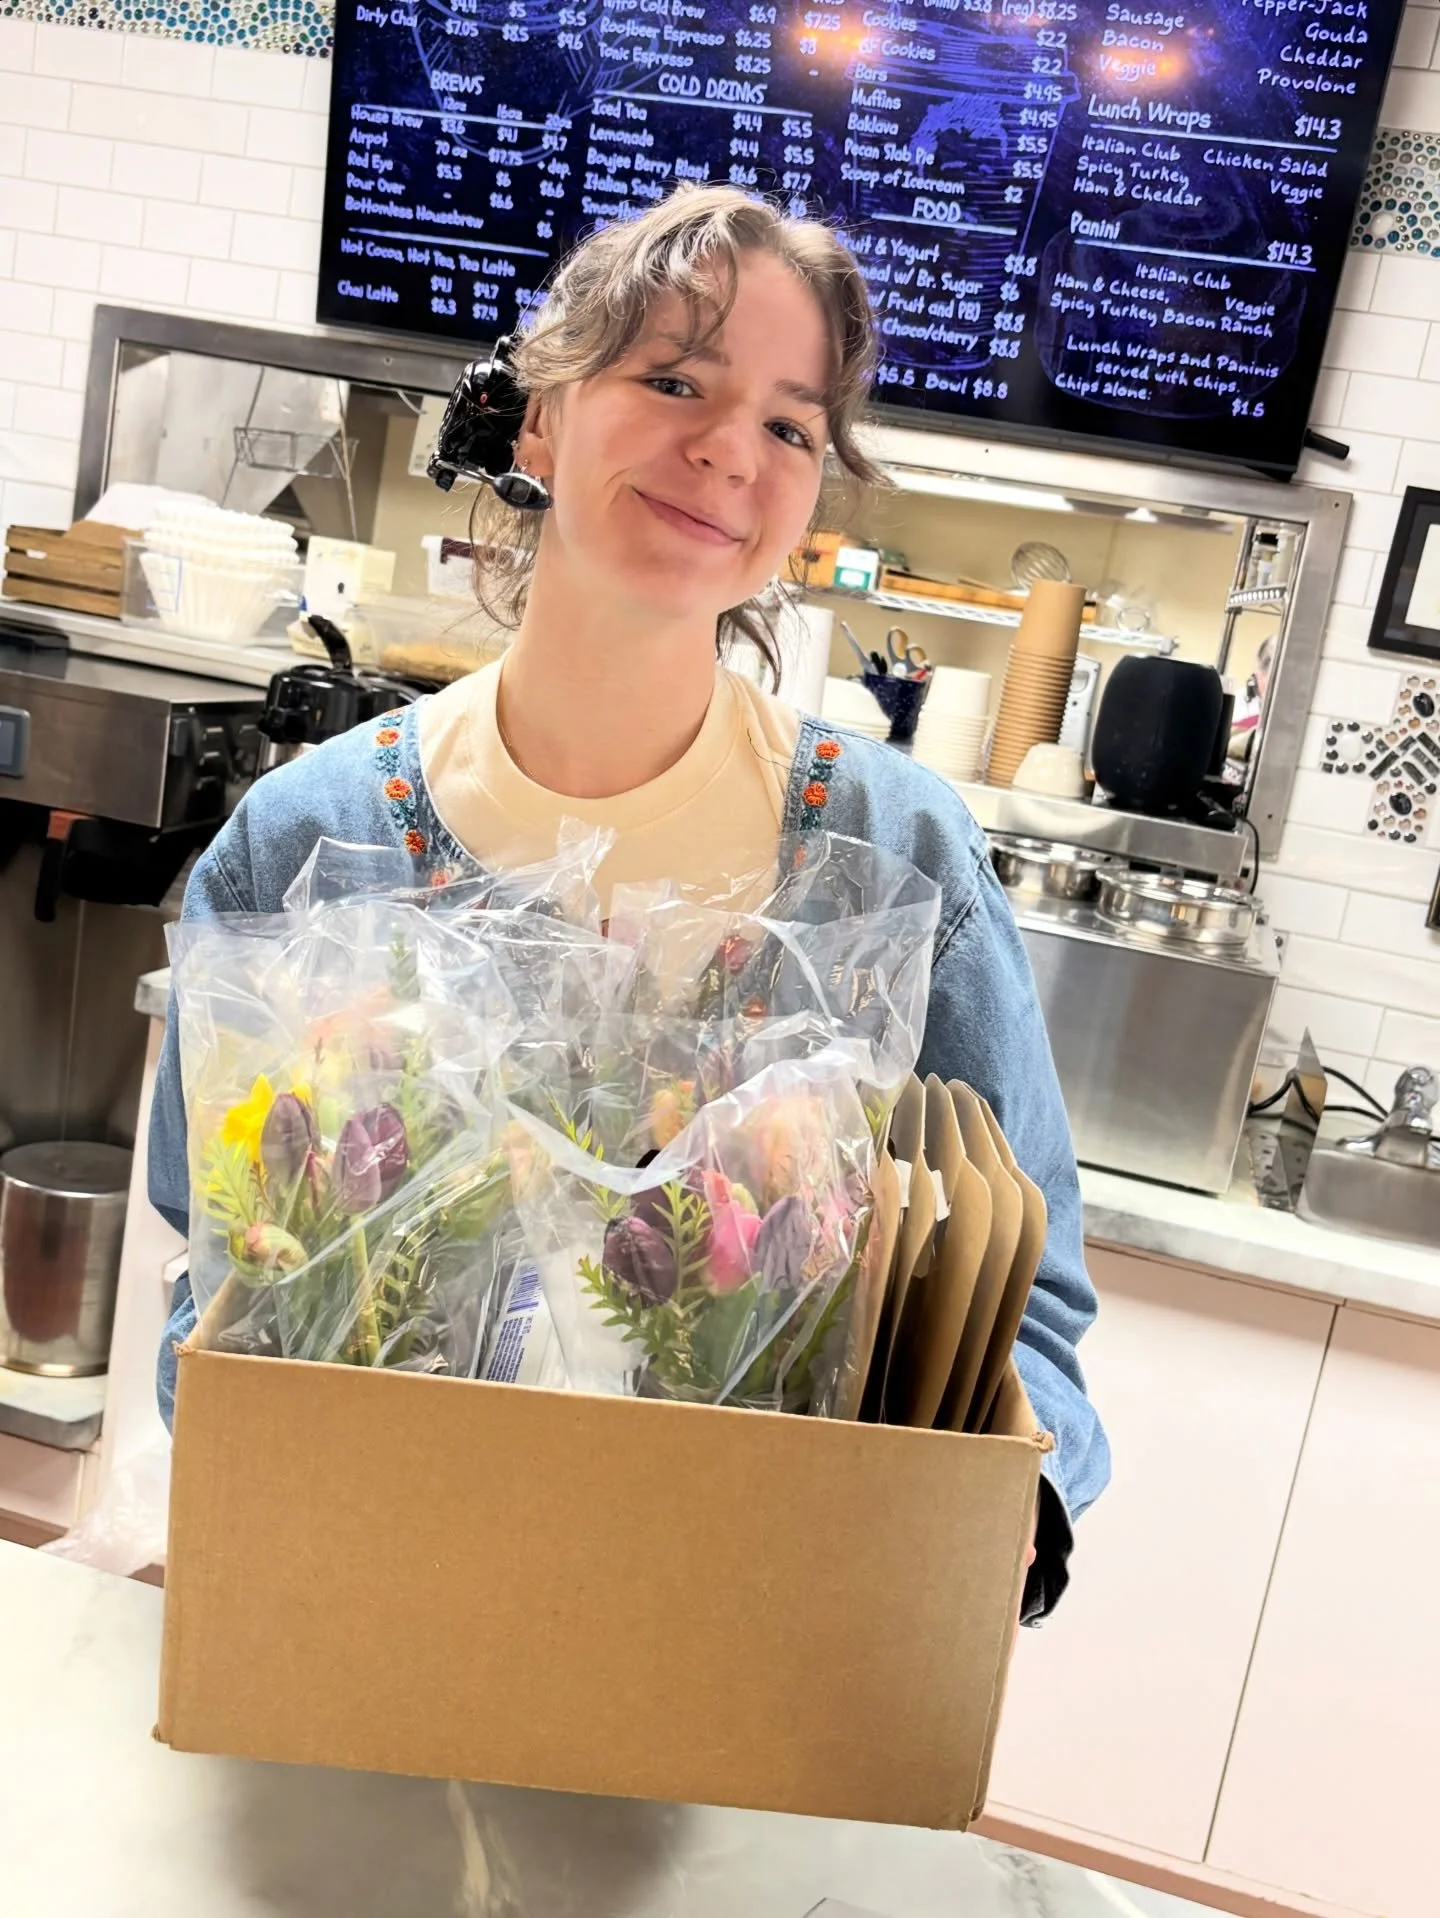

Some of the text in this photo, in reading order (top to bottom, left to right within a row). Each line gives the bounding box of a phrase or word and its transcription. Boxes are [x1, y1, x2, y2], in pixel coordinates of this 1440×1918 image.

[356, 5, 583, 50] Dirty Chai $7.05 $8.5 $9.6
[509, 2, 526, 18] $5
[559, 8, 587, 27] $5.5
[640, 0, 841, 31] Cold Brew $6.9 $7.25
[863, 10, 1067, 49] Cookies $2.2
[1001, 1, 1034, 23] (reg)
[1038, 1, 1077, 21] $8.25
[1106, 3, 1185, 35] Sausage
[600, 17, 661, 39] Rootbeer
[663, 25, 725, 47] Espresso
[735, 28, 772, 48] $6.25
[1102, 29, 1164, 52] Bacon
[1305, 22, 1368, 44] Gouda
[599, 42, 772, 74] Tonic Espresso $8.25
[881, 39, 936, 61] Cookies
[1032, 54, 1063, 76] $2.2
[1099, 54, 1156, 82] Veggie
[1280, 44, 1363, 70] Cheddar
[430, 70, 485, 95] BREWS
[658, 72, 767, 105] COLD DRINKS
[855, 62, 1063, 102] Bars $4.95
[1257, 68, 1356, 94] Provolone
[591, 98, 813, 139] Iced Tea $4.4 $5.5
[851, 87, 1058, 128] Muffins $4.95
[1088, 94, 1342, 140] Lunch Wraps $14.3
[351, 104, 567, 151] House Brew $3.6 $4.7
[589, 123, 815, 166] Lemonade $4.4 $5.5
[847, 112, 1048, 154] Baklava $5.5
[350, 127, 388, 150] Airpot
[435, 140, 449, 155] 70
[488, 147, 523, 166] $17.75
[548, 157, 571, 180] dep.
[587, 146, 812, 192] Boujee Berry Blast $6.6 $7.7
[844, 137, 1044, 180] Pecan Slab Pie $5.5
[1082, 134, 1328, 178] Italian Club Chicken Salad
[347, 172, 514, 210] Pour Over $6.6
[348, 150, 565, 198] Red Eye $5.5 $6 $6.6
[584, 172, 663, 199] Italian Soda
[840, 162, 1023, 204] Scoop of Icecream $2
[1073, 177, 1202, 207] Ham & Cheddar
[1077, 156, 1323, 204] Spicy Turkey Veggie
[345, 195, 553, 239] Bottomless Housebrew $6
[912, 197, 961, 222] FOOD
[341, 238, 515, 277] Hot Cocoa, Hot Tea, Tea Latte
[875, 239, 887, 255] &
[890, 238, 940, 265] Yogurt
[1004, 253, 1038, 277] $8.8
[1070, 210, 1313, 266] Panini $14.3
[473, 281, 499, 299] $4.7
[894, 268, 1020, 302] w/ Br. Sugar $6
[1055, 272, 1276, 321] Ham & Cheese, Veggie
[1135, 263, 1231, 291] Italian Club
[338, 280, 363, 297] Chai
[366, 284, 399, 303] Latte
[431, 297, 456, 315] $6.3
[472, 302, 498, 321] $7.4
[888, 291, 925, 313] Fruit
[928, 299, 954, 318] and
[994, 311, 1025, 333] $8.8
[1050, 292, 1273, 338] Spicy Turkey Bacon Ranch
[882, 318, 1020, 359] Choco/cherry $8.8
[1067, 335, 1279, 378] Lunch Wraps and Paninis
[877, 363, 915, 386] $5.5
[925, 372, 968, 395] Bowl
[973, 377, 1008, 400] $8.8
[1055, 373, 1265, 418] Chips alone: $1.5
[1096, 361, 1241, 396] served with chips.
